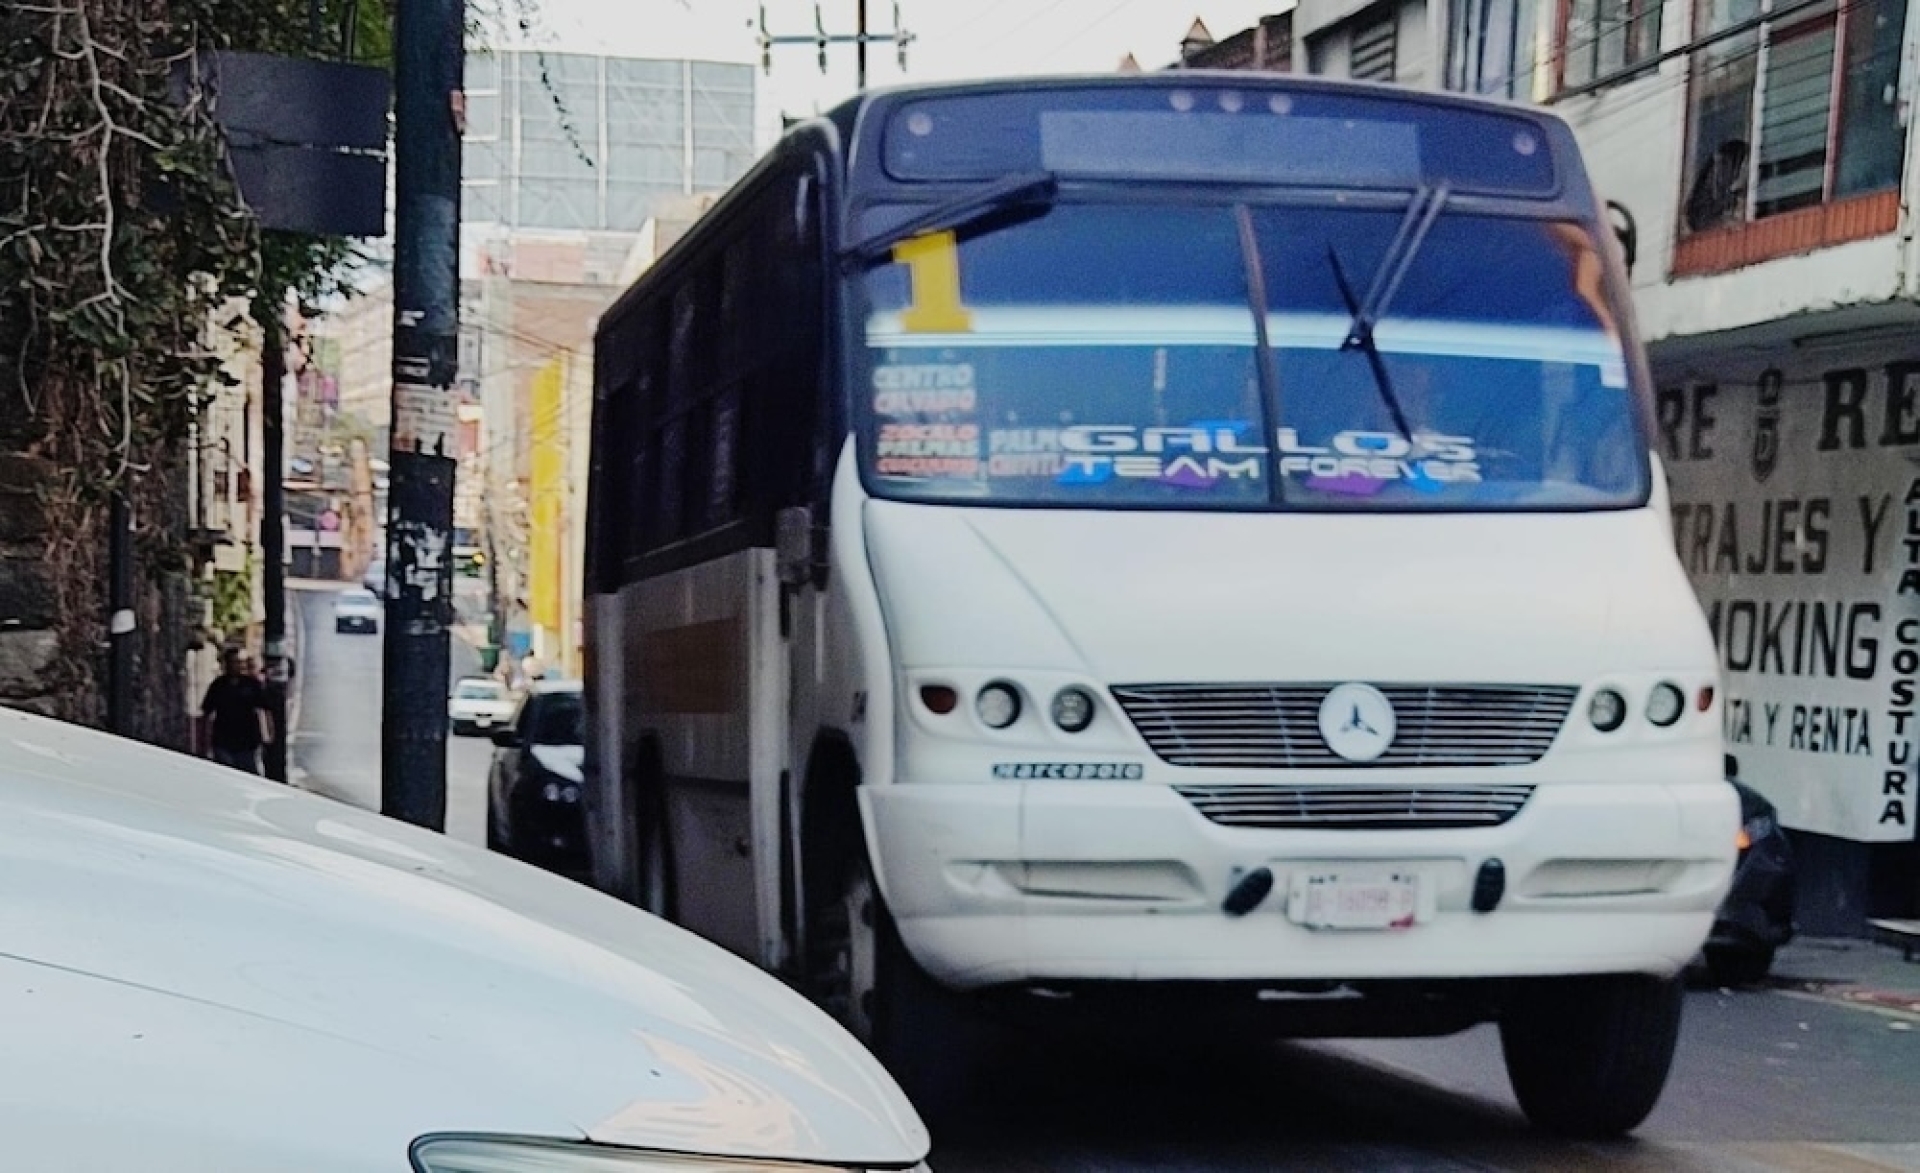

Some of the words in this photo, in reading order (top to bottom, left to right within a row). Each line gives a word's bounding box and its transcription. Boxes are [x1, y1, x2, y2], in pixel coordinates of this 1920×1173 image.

[894, 228, 974, 334] 1
[1063, 455, 1261, 479] TEAM
[1672, 500, 1829, 575] TRAJES
[1860, 495, 1890, 573] Y
[1763, 703, 1781, 746] Y
[1790, 706, 1872, 757] RENTA
[1878, 618, 1920, 826] COSTURA
